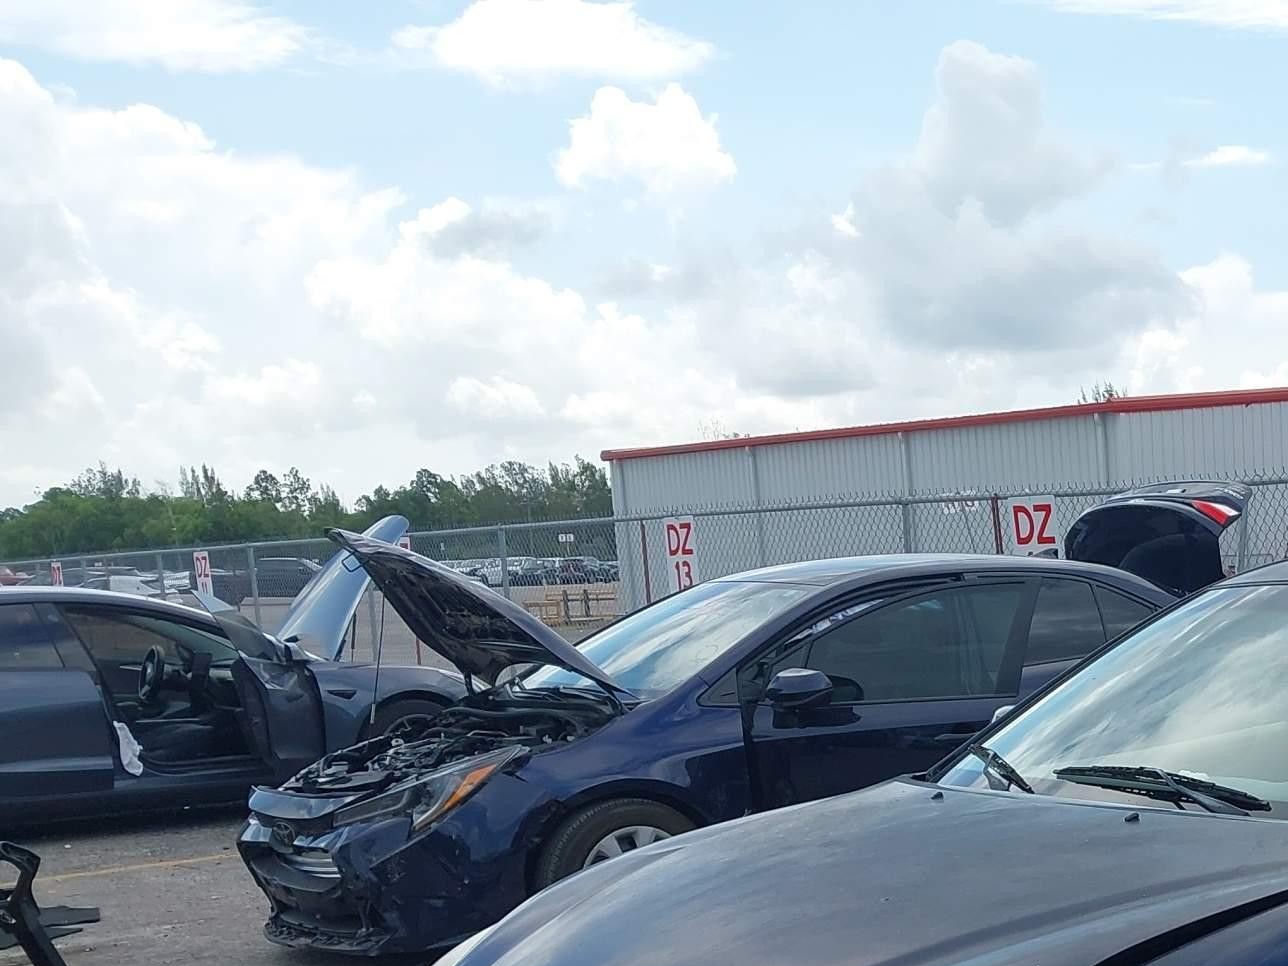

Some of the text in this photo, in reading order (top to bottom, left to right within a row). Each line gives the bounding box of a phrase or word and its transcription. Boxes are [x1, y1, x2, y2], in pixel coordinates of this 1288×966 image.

[666, 523, 693, 556] DZ
[1013, 504, 1056, 545] DZ
[195, 556, 209, 577] DZ
[675, 560, 693, 591] 13
